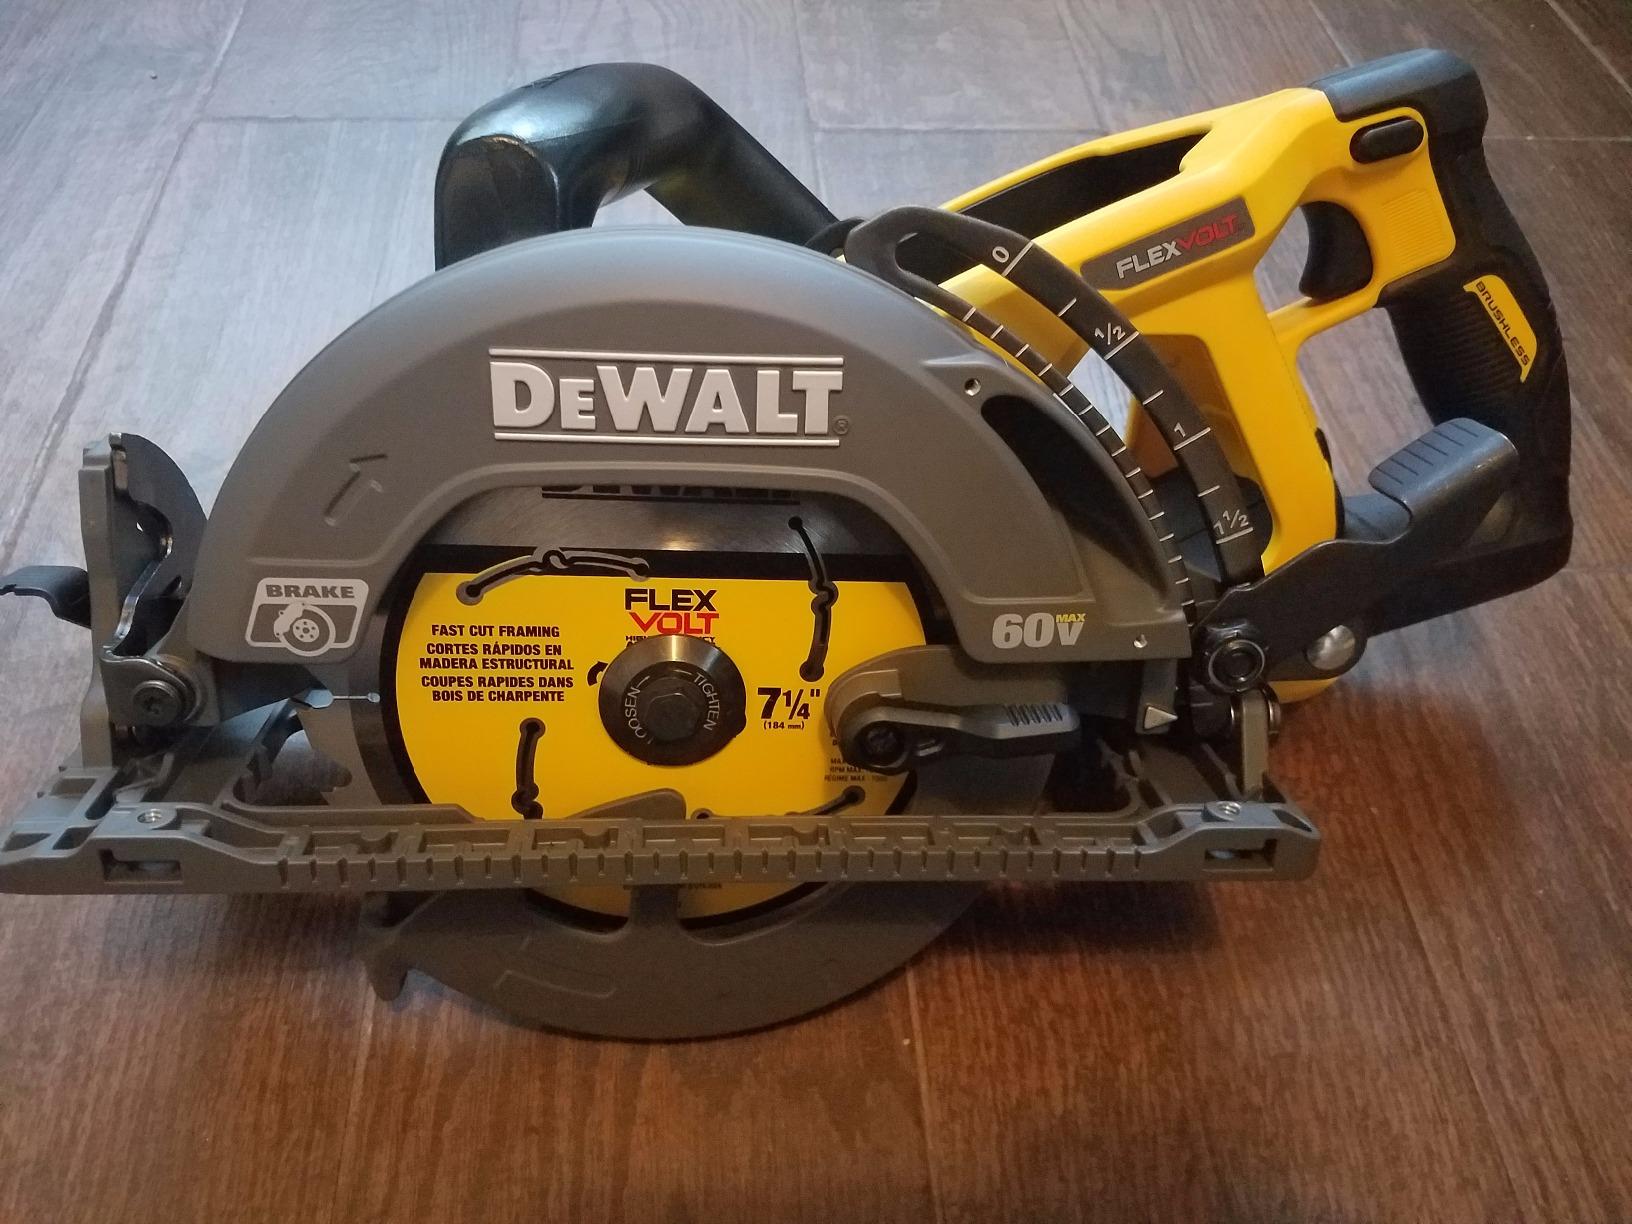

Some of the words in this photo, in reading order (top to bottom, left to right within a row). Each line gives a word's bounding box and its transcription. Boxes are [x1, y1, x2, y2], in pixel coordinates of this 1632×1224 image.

[1115, 213, 1238, 279] FLEXVOLT
[992, 246, 1010, 263] 0
[1476, 280, 1530, 366] BRUSHLESS
[1094, 322, 1126, 345] 1/2
[1173, 422, 1186, 437] 1
[265, 584, 355, 599] BRAKE
[625, 588, 718, 612] FLEX
[628, 611, 720, 634] VOLT
[1055, 613, 1087, 623] MAX
[431, 624, 465, 636] FAST
[469, 625, 494, 637] CUT
[499, 626, 560, 638] FRAMING
[992, 612, 1085, 649] 60V
[426, 643, 478, 655] CORTES
[482, 641, 541, 656] RÁPIDOS
[545, 645, 562, 656] EN
[419, 658, 478, 669] MADERA
[482, 658, 574, 670] ESTRUCTURAL
[421, 676, 473, 688] COUPES
[478, 676, 535, 688] RAPIDES
[538, 677, 574, 688] DANS
[432, 690, 464, 702] BOIS
[467, 690, 484, 702] DE
[488, 691, 565, 702] CHARPENTE
[693, 672, 720, 731] TIGHTEN
[763, 721, 785, 730] (184
[787, 721, 805, 730] mm)
